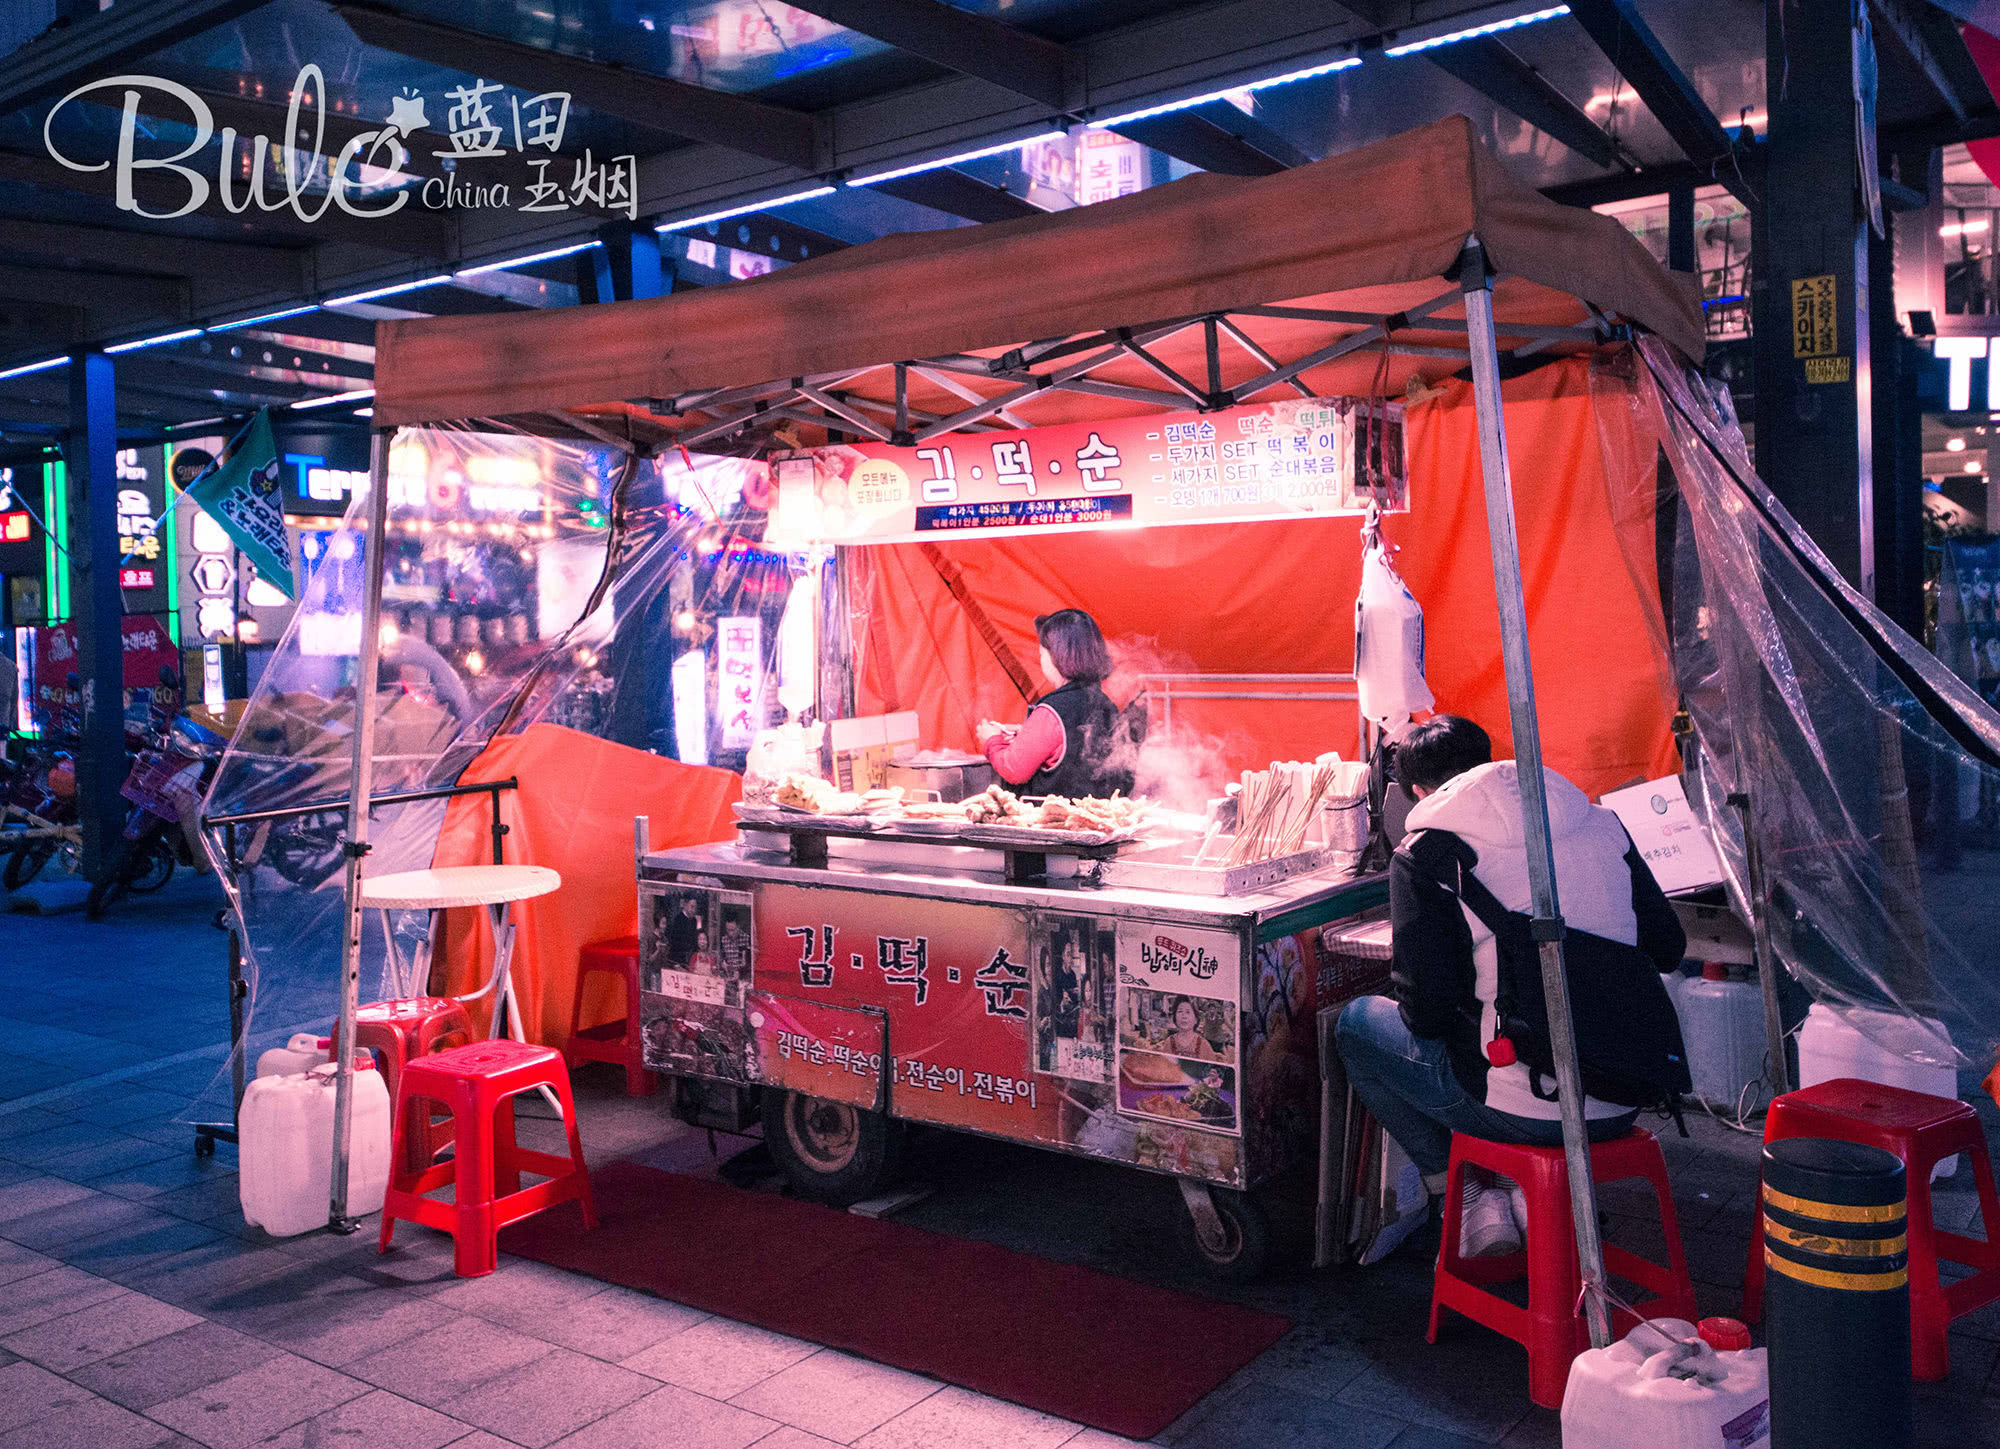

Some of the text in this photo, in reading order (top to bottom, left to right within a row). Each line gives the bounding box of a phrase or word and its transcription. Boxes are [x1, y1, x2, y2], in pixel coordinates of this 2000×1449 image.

[1934, 336, 2000, 411] T
[1166, 422, 1215, 443] 김떡순
[1239, 415, 1274, 435] 떡순
[1168, 444, 1216, 464] 두가지
[1223, 441, 1258, 459] SET
[1172, 466, 1219, 485] 세가지
[1225, 464, 1260, 480] SET
[1141, 942, 1182, 975] 밥상의
